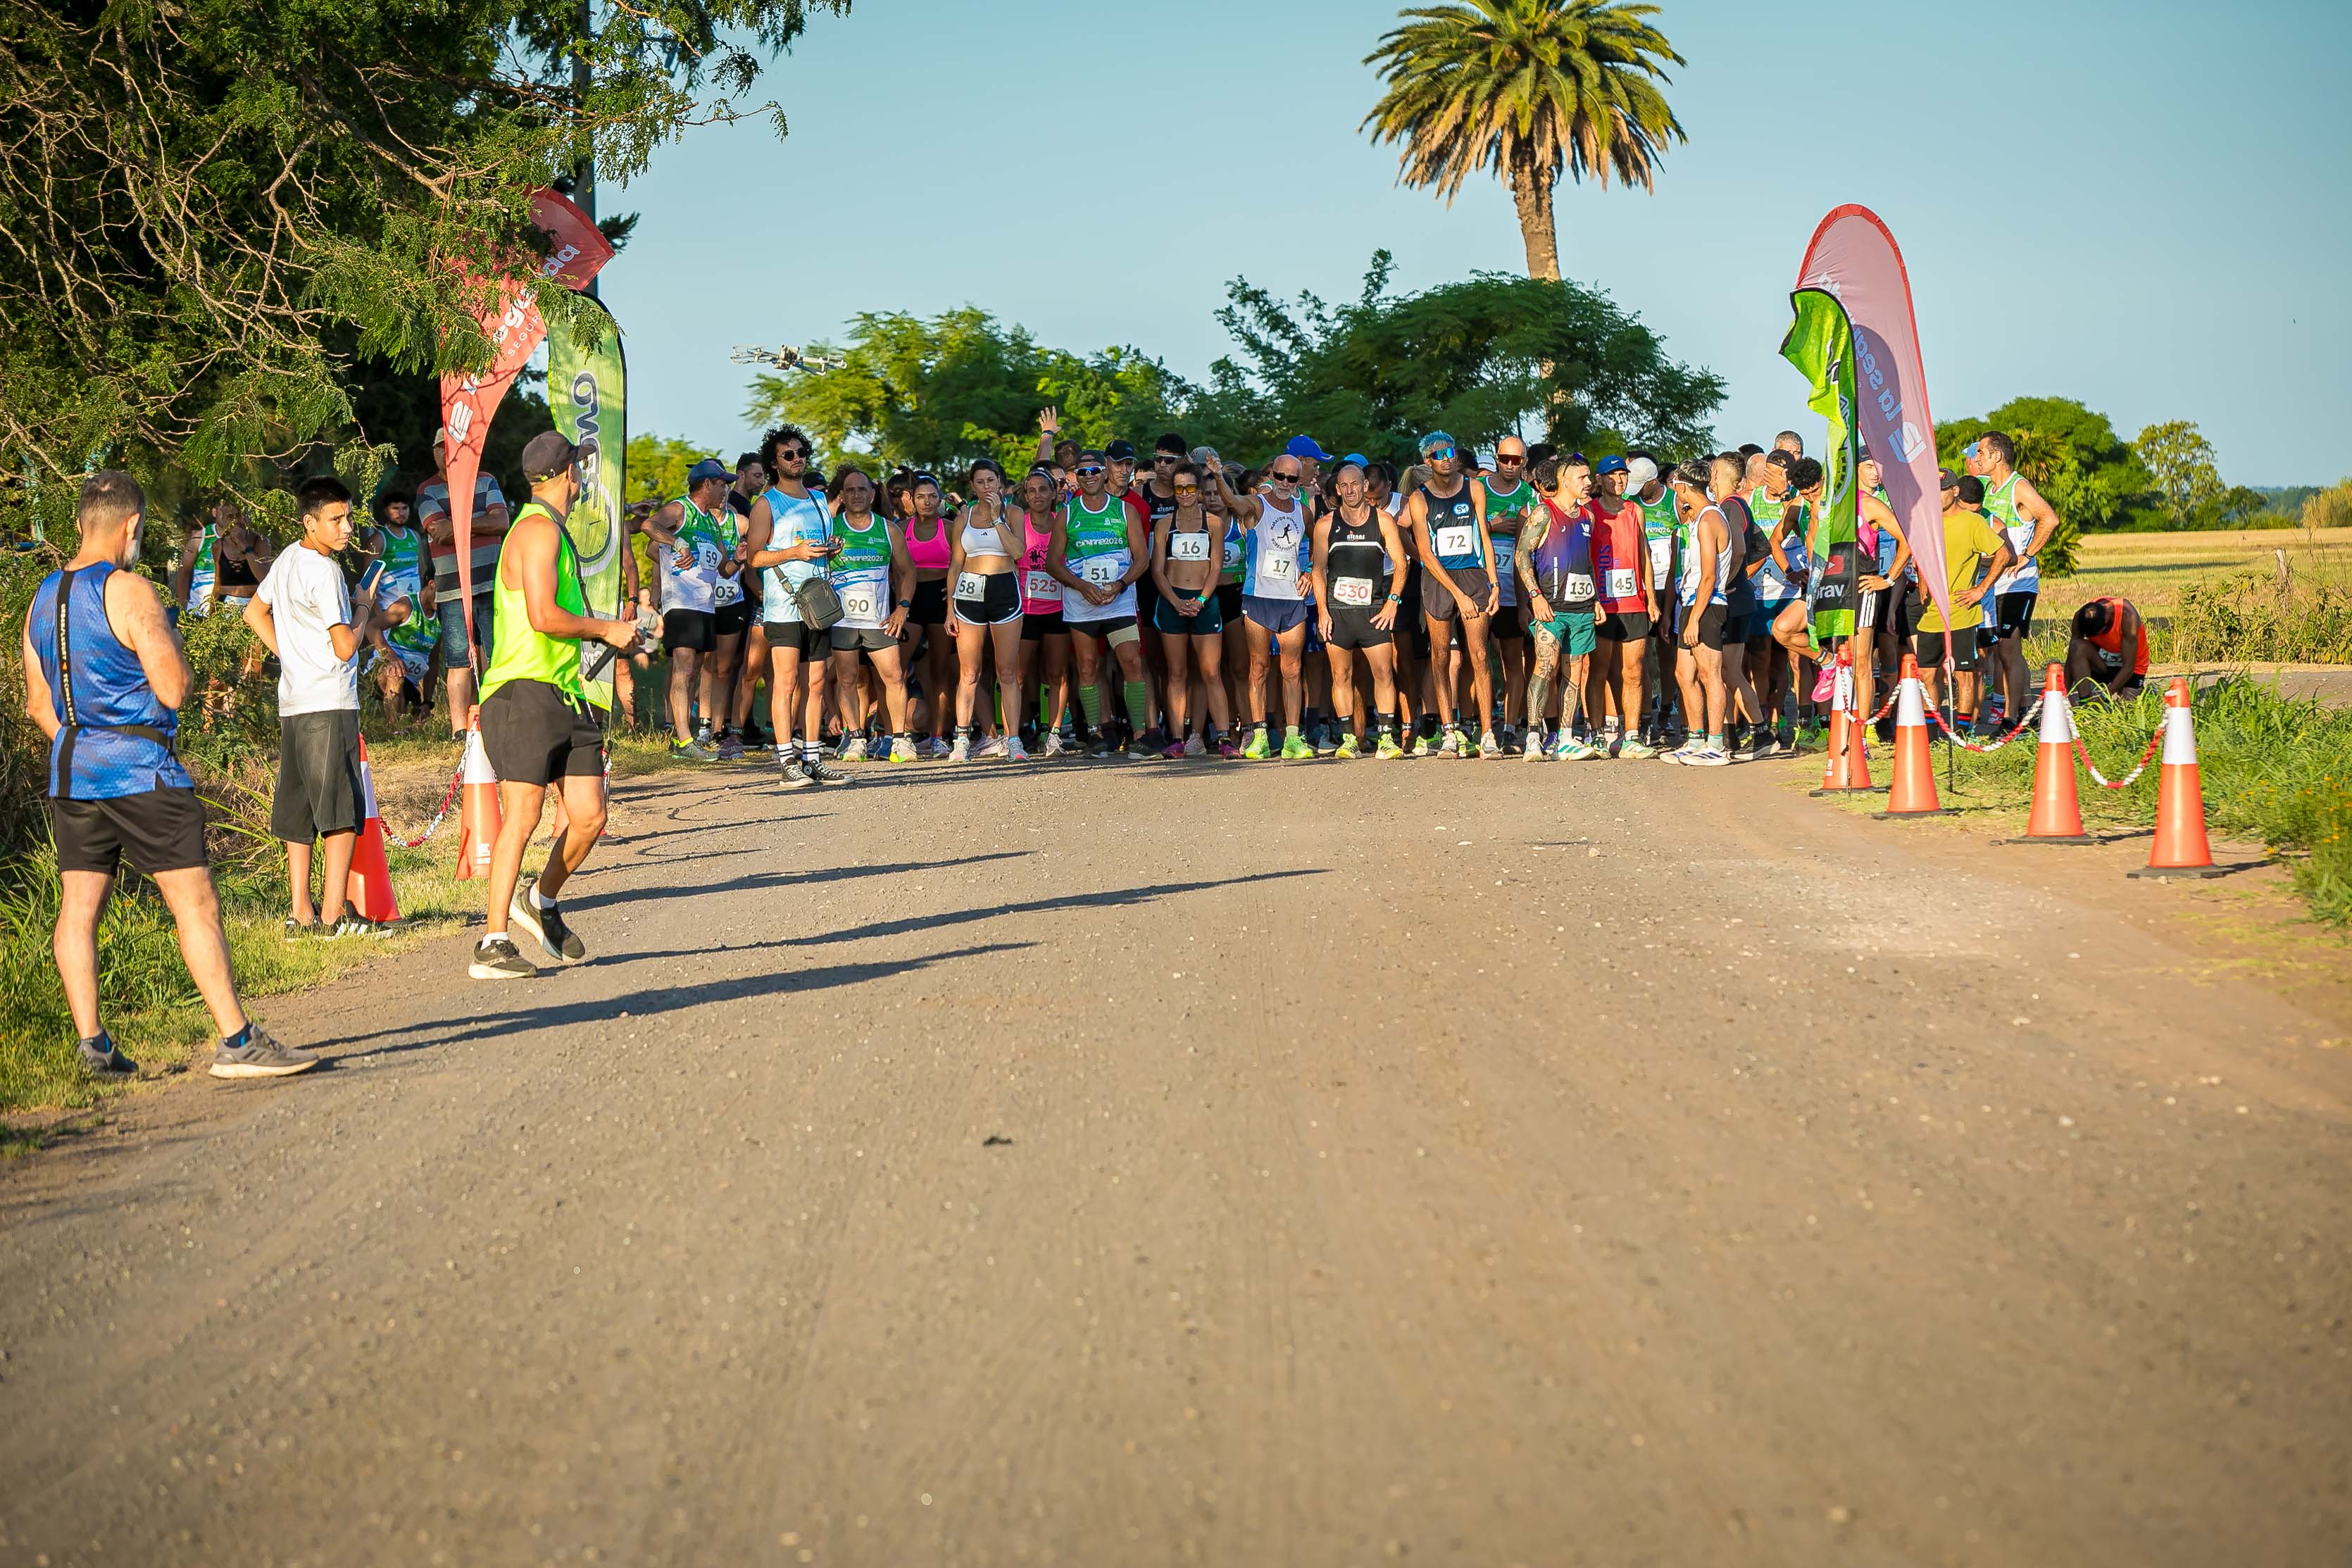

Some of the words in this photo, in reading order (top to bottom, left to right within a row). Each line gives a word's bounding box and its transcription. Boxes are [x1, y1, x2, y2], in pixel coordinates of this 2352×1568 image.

[1182, 541, 1200, 554] 16
[1447, 535, 1465, 548] 72
[706, 550, 718, 565] 59
[1273, 560, 1290, 573] 17
[1091, 567, 1110, 581] 51
[958, 579, 975, 594] 58
[1030, 577, 1057, 593] 525
[1570, 582, 1593, 595] 130
[1615, 577, 1632, 590] 45
[1337, 584, 1368, 599] 530
[848, 598, 869, 613] 90
[408, 661, 422, 675] 26
